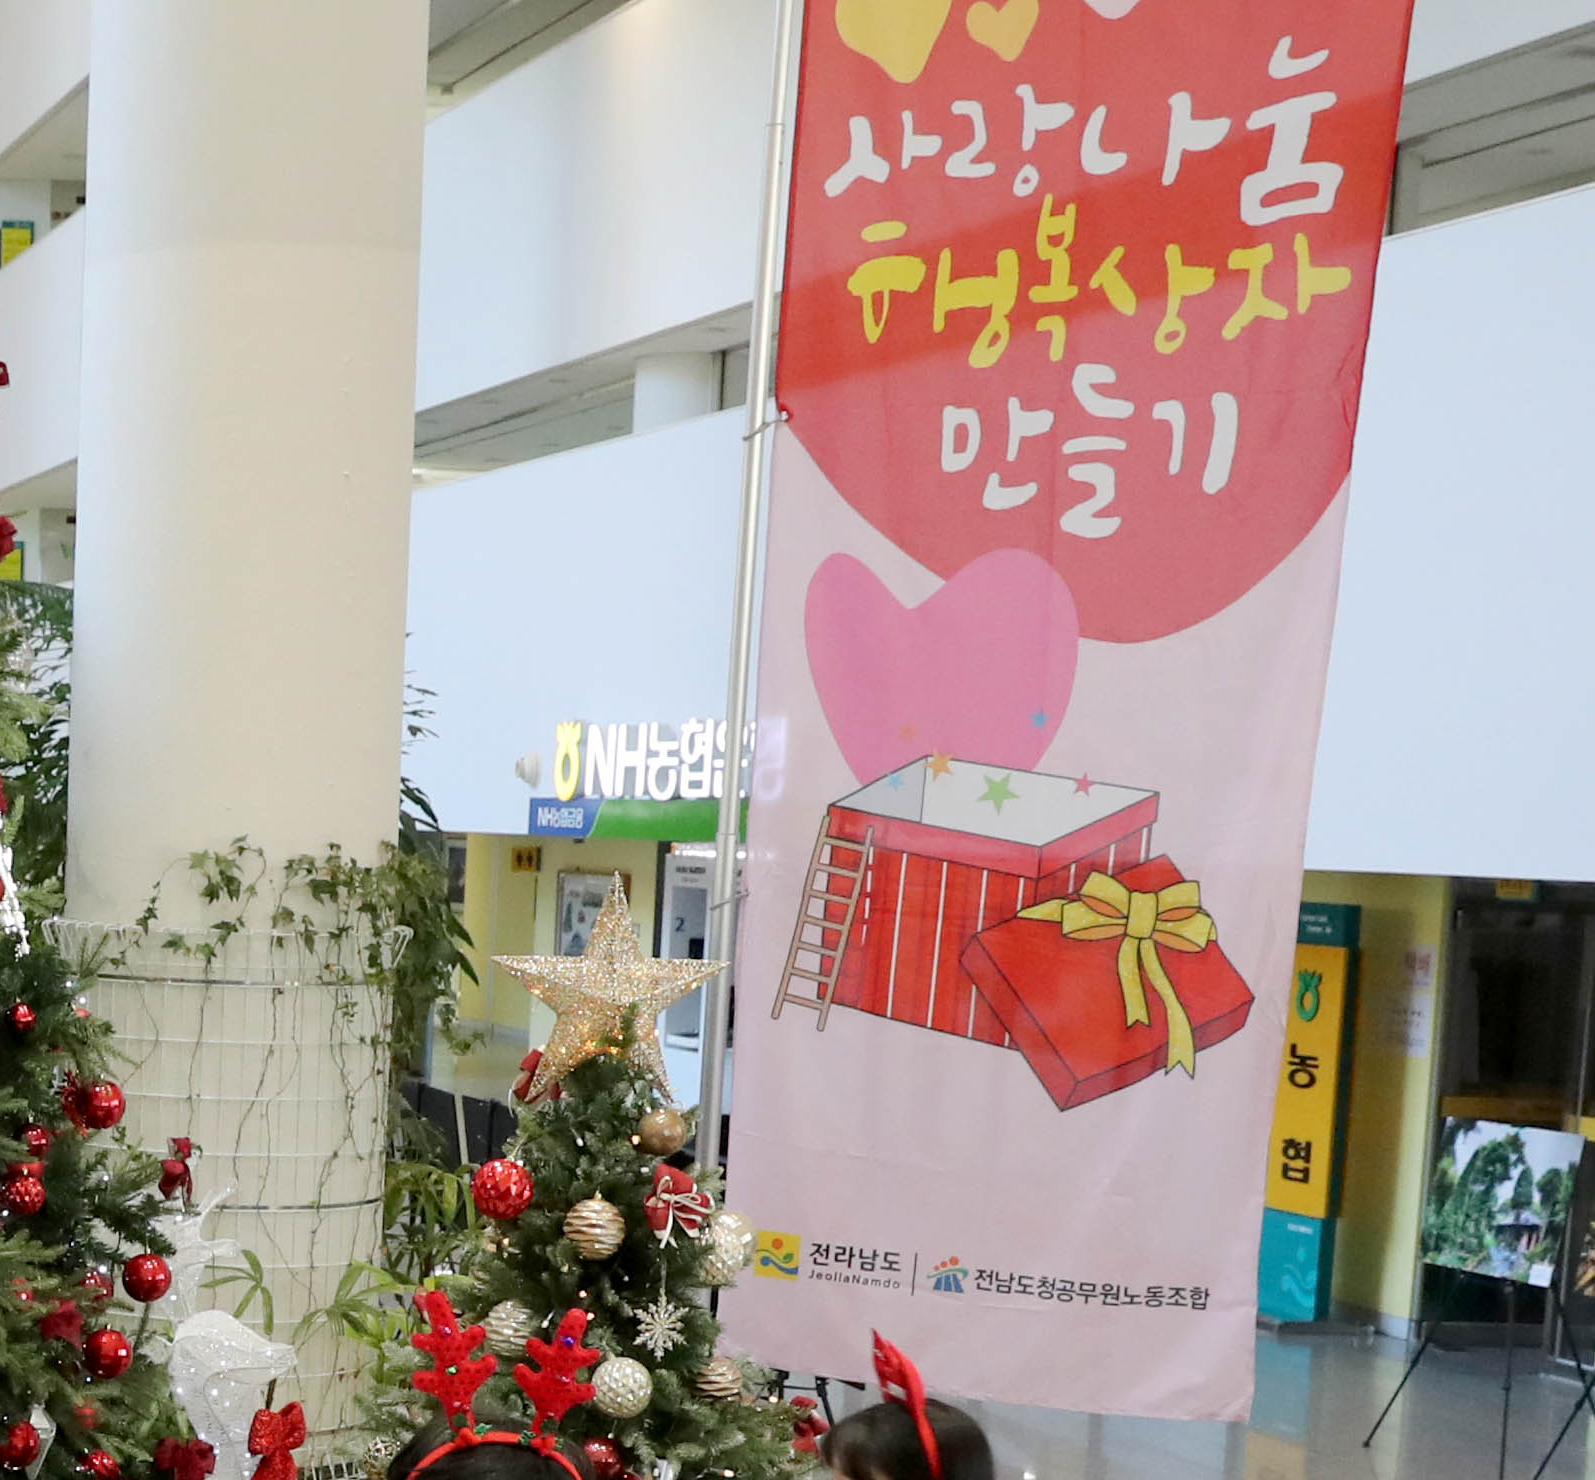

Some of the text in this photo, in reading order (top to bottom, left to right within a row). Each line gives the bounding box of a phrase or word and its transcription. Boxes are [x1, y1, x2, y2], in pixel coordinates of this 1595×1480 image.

[941, 363, 1239, 538] 만들기
[809, 1243, 902, 1272] 전라남도
[974, 1268, 1211, 1310] 전남도청공무원노동조합
